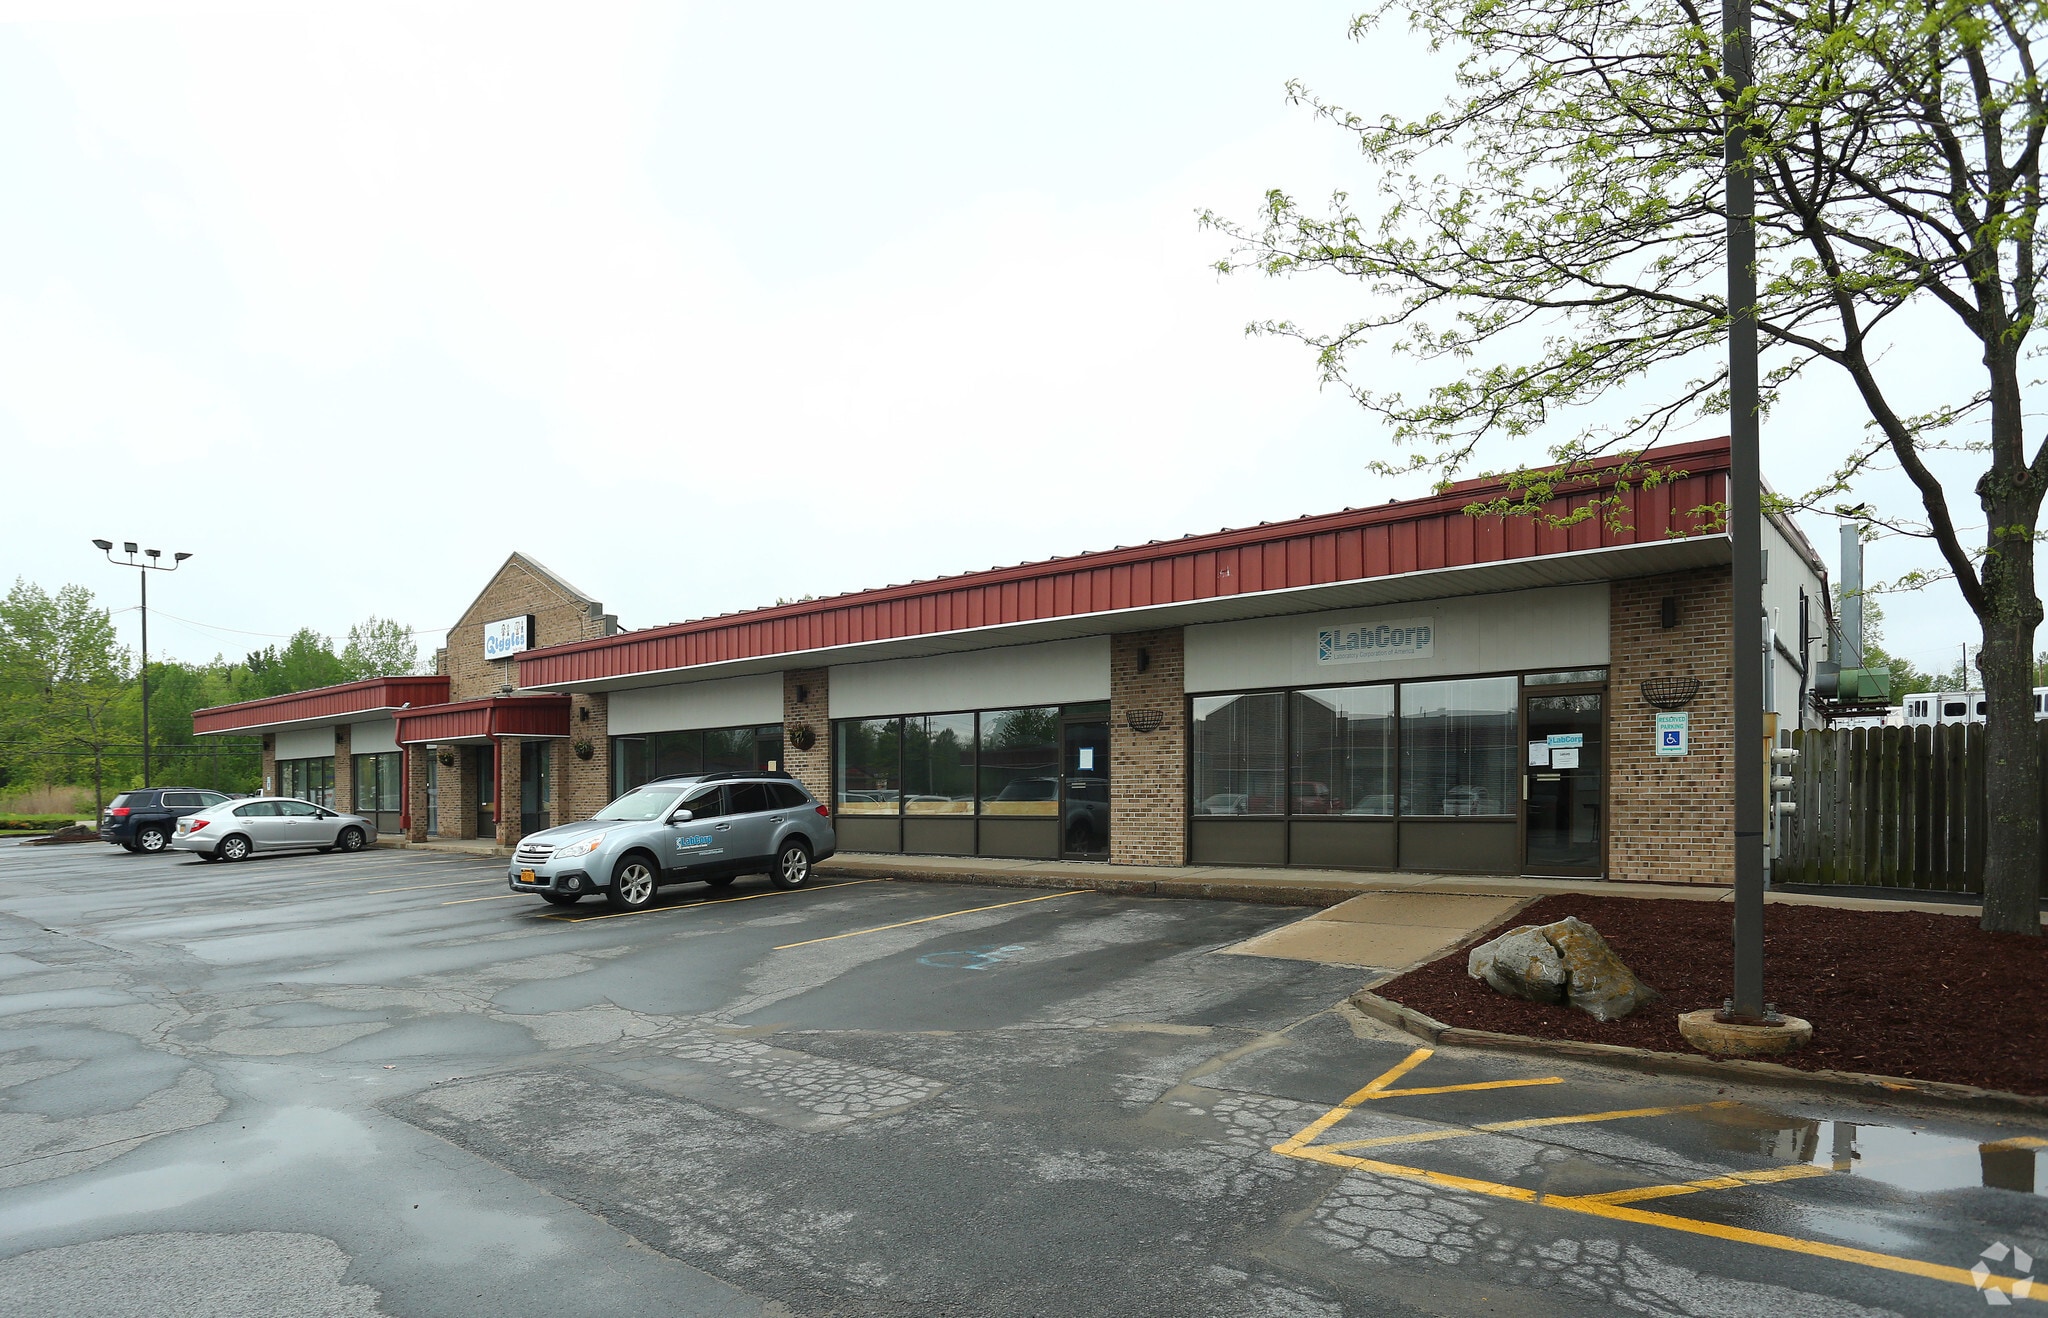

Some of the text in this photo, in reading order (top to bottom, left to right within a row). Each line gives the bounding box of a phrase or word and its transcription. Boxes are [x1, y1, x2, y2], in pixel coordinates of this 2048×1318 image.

[486, 632, 525, 655] Giggles
[1333, 625, 1431, 651] LabCorp
[1552, 735, 1583, 744] LabCorp
[681, 835, 713, 846] LabCorp
